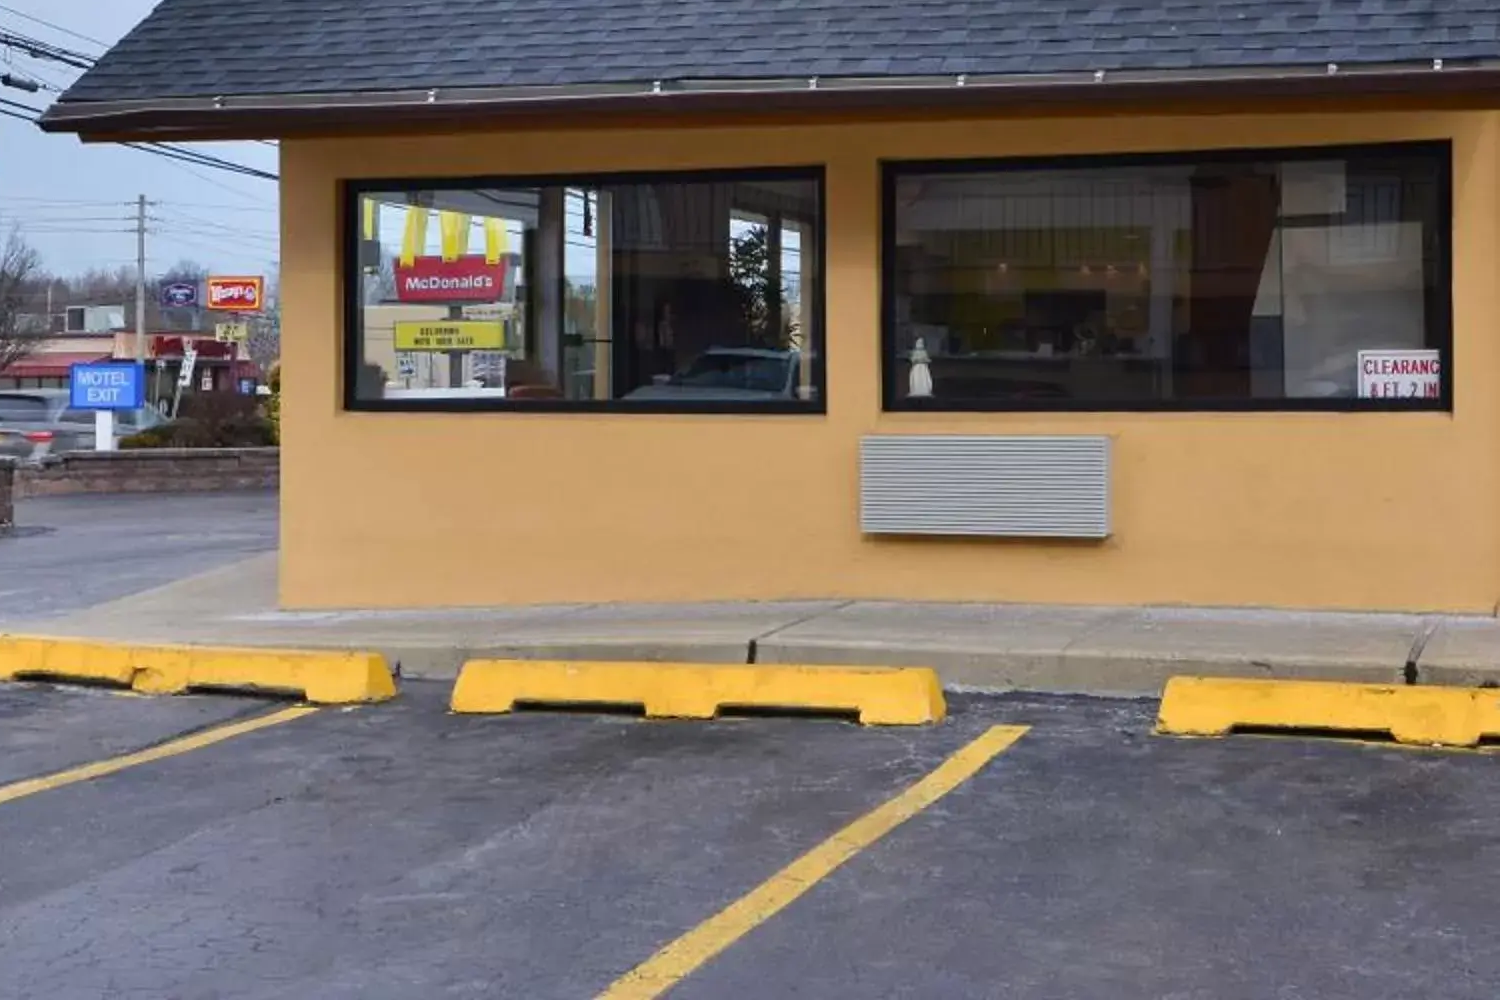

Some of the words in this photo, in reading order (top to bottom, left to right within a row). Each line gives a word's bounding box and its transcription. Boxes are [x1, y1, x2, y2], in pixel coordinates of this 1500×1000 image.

[405, 275, 493, 291] McDonald's
[1364, 359, 1440, 375] CLEARANC
[77, 371, 130, 386] MOTEL
[87, 387, 121, 402] EXIT
